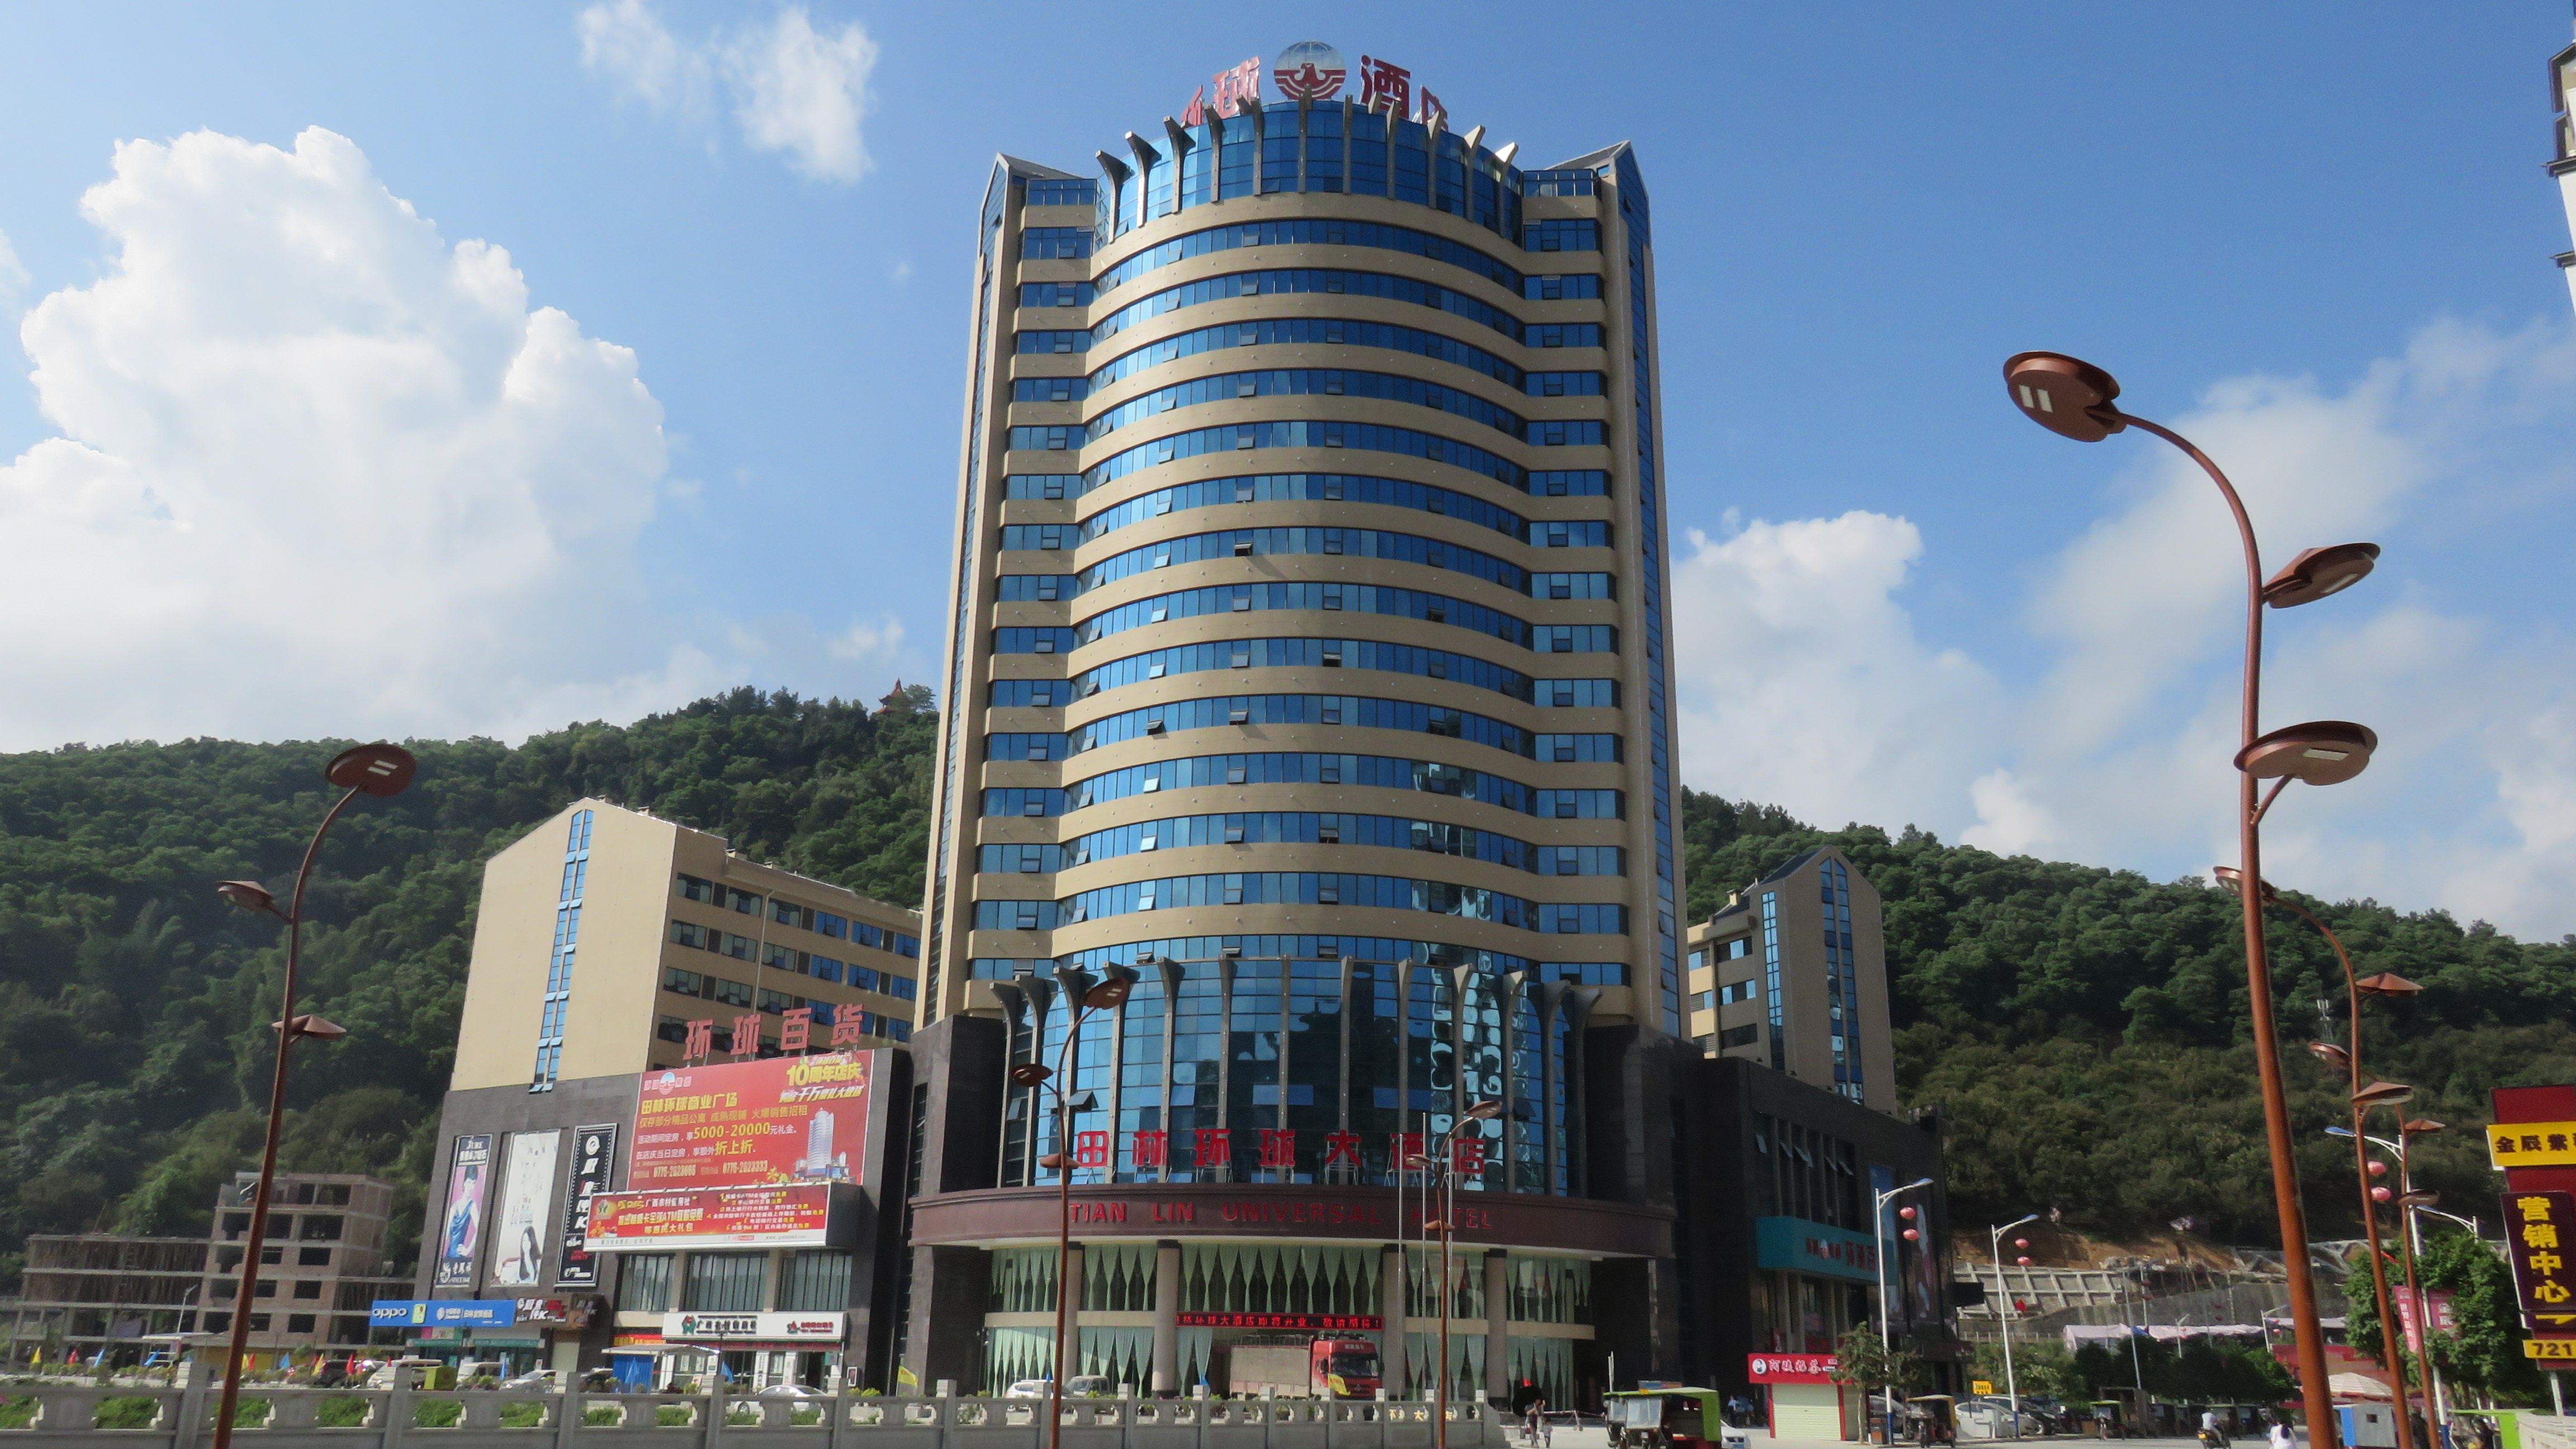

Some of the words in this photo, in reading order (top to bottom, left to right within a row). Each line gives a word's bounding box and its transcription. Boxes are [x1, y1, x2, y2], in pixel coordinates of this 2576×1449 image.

[683, 1004, 863, 1060] 环球百货
[786, 1062, 863, 1086] 10周年店庆
[641, 1092, 737, 1115] 田林环球商业广场
[1077, 1129, 1485, 1174] 田林环球大酒店
[1069, 1202, 1127, 1221] TIAN
[1152, 1202, 1194, 1221] LIN
[1223, 1202, 1381, 1224] UNIVERSAL
[2517, 1197, 2571, 1303] 营销中心
